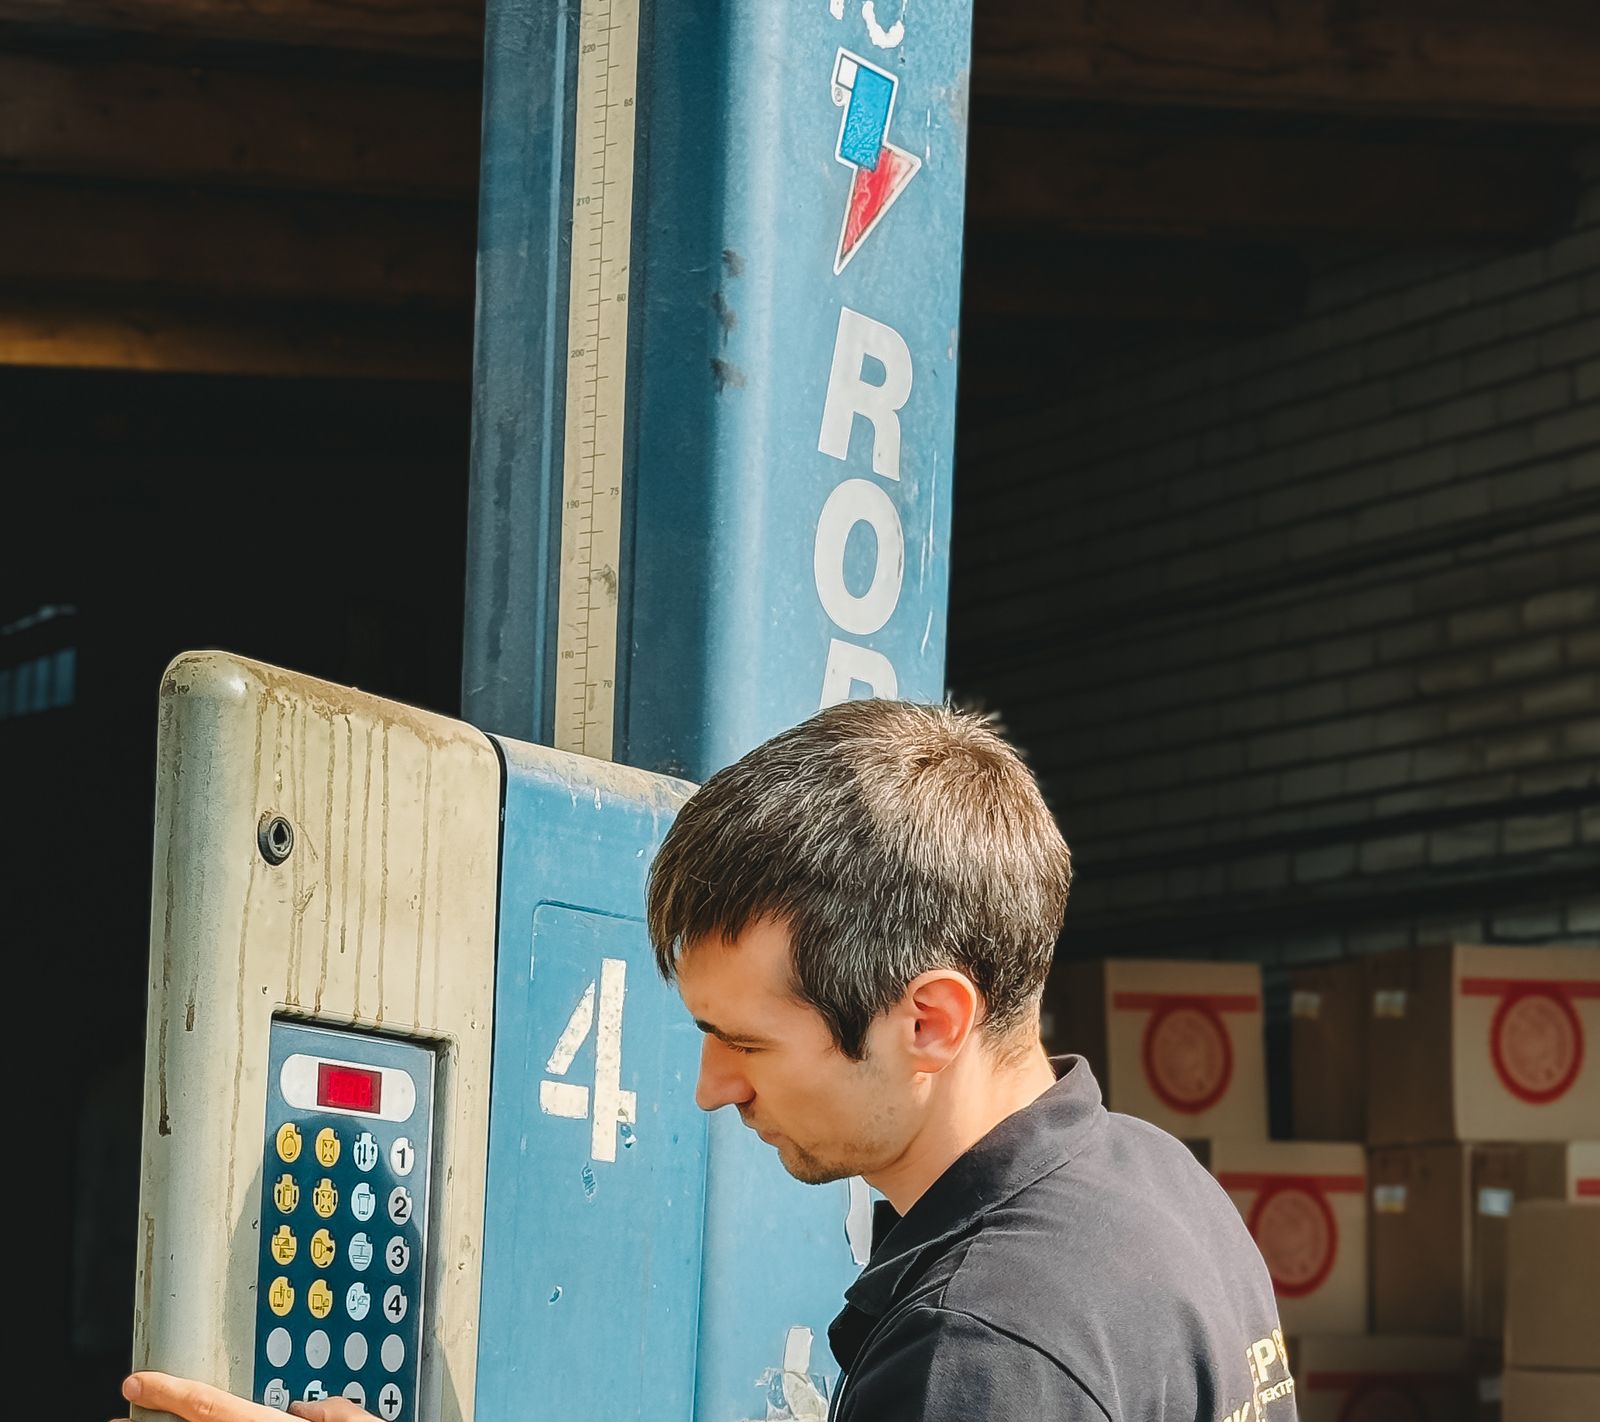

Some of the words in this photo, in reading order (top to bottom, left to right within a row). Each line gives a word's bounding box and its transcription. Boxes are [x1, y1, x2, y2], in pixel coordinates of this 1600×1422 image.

[577, 196, 590, 206] 210
[571, 349, 584, 358] 200
[610, 487, 619, 496] 75
[566, 500, 580, 509] 190
[604, 680, 613, 688] 70
[540, 957, 637, 1163] 4
[396, 1147, 406, 1169] 1
[394, 1196, 408, 1218] 2
[391, 1245, 404, 1267] 3
[388, 1294, 402, 1316] 4
